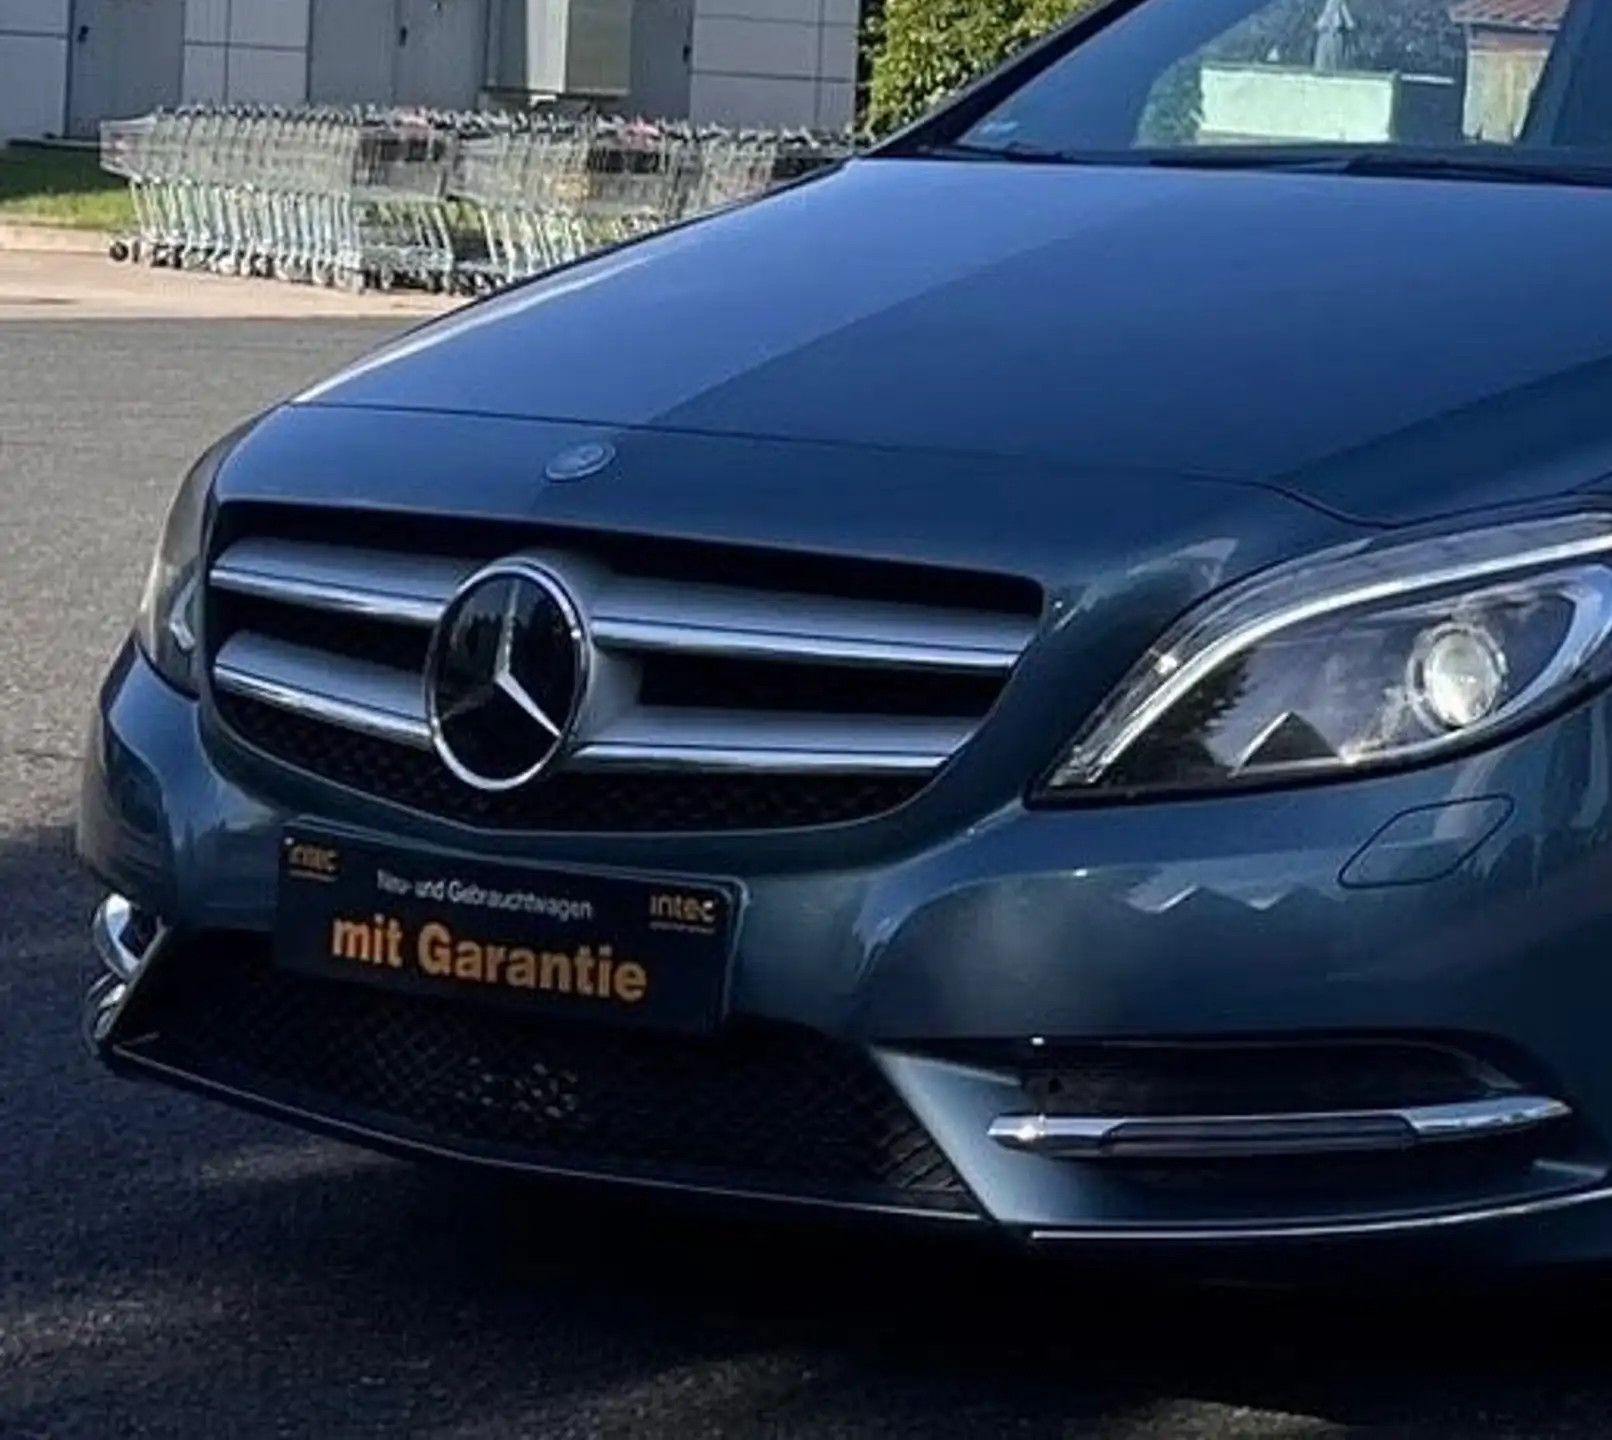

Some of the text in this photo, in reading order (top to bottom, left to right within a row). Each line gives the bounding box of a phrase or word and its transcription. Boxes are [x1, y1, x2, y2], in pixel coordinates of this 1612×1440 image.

[414, 878, 445, 902] und
[447, 878, 594, 922] Gebrauchtwagen
[331, 913, 648, 1003] mit Garantie
